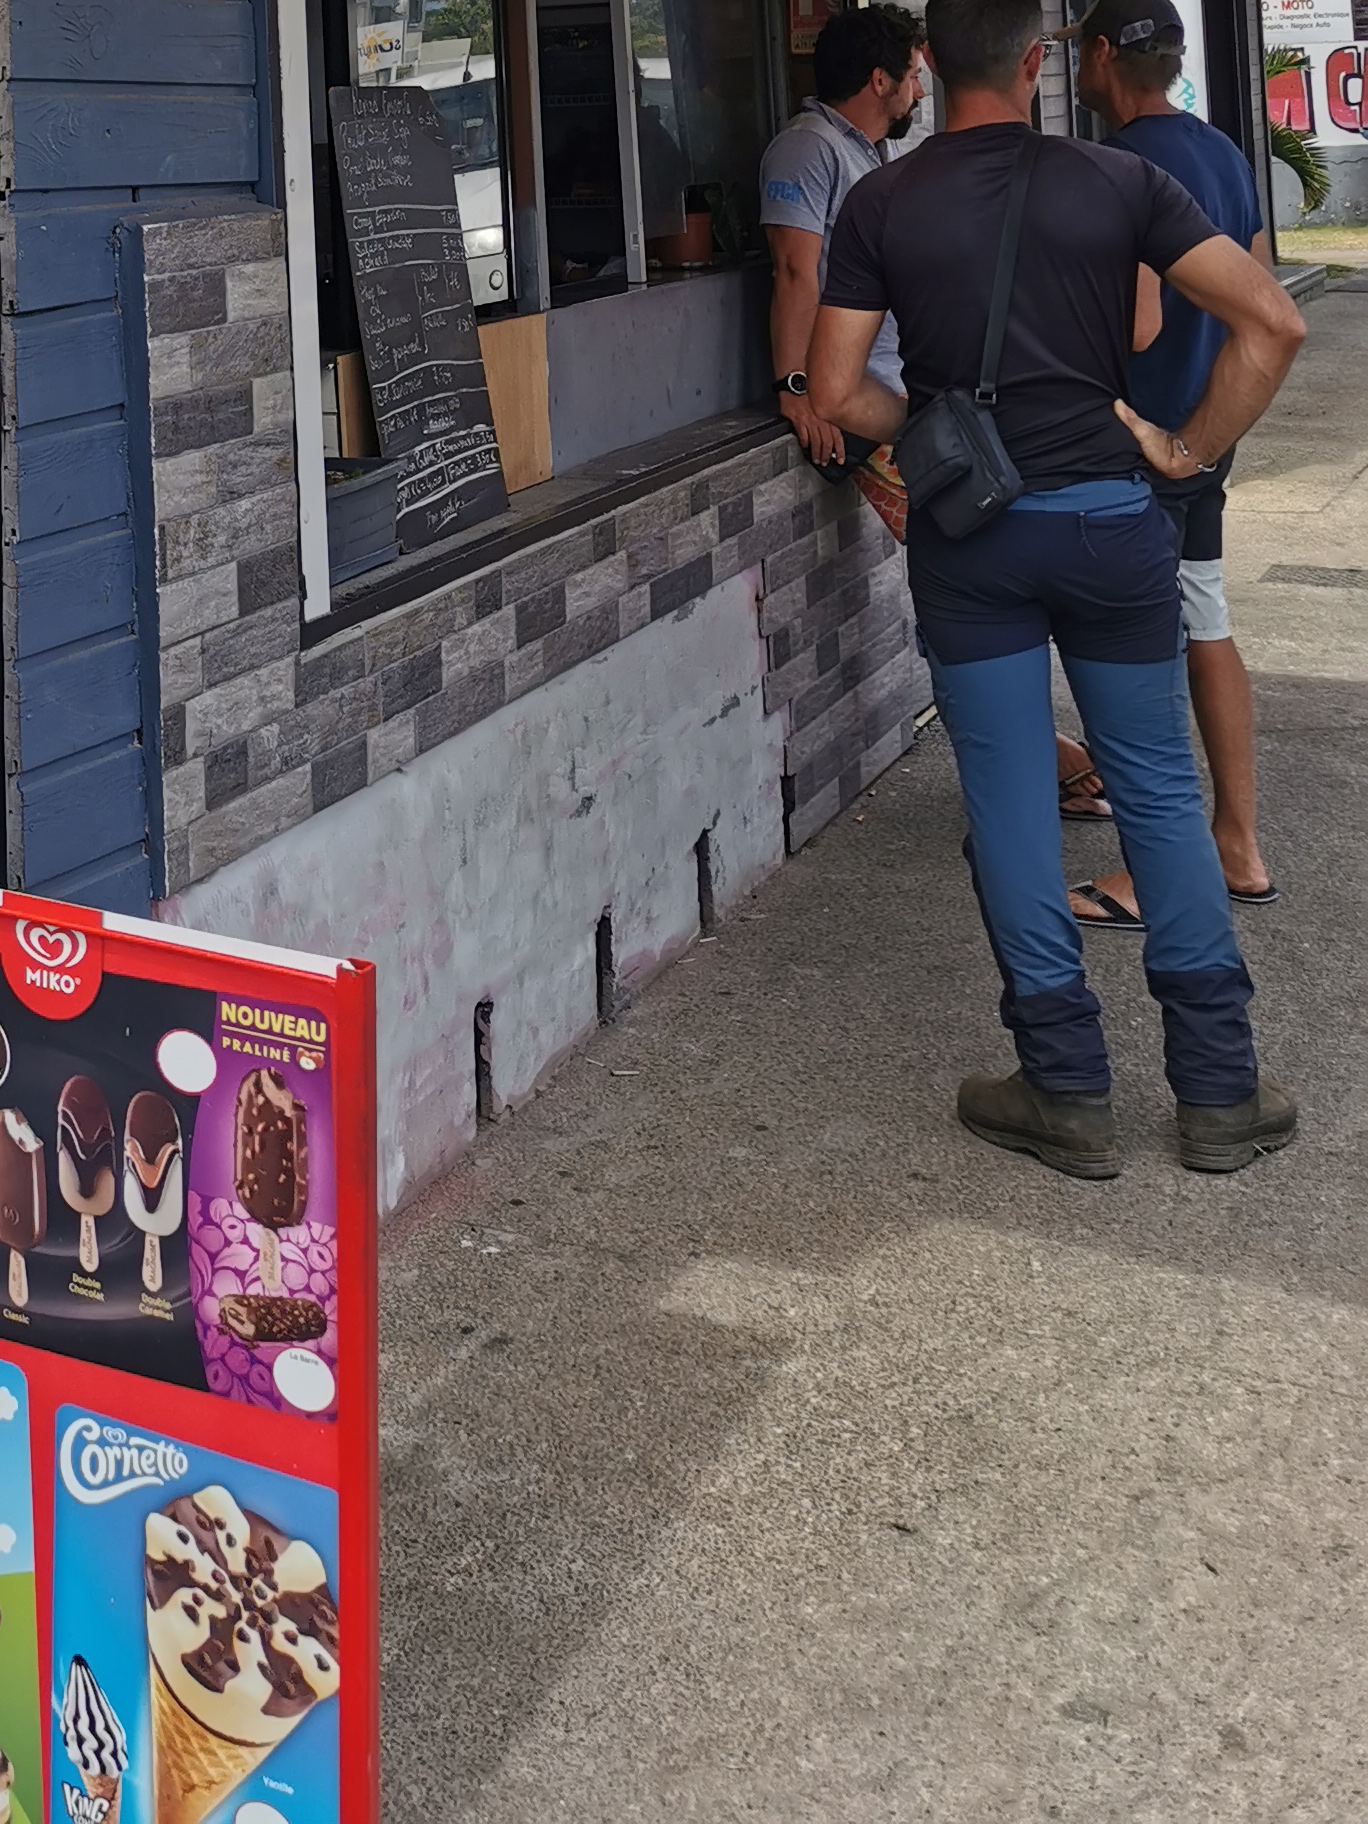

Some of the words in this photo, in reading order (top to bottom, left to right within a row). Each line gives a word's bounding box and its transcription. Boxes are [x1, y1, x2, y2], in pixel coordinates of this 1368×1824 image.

[1281, 0, 1315, 11] MOTO
[25, 965, 76, 995] MIKO
[220, 1000, 327, 1043] NOUVEAU
[222, 1035, 291, 1063] PRALINÉ
[68, 1282, 107, 1302] Chocolat
[71, 1272, 102, 1290] Double
[59, 1417, 189, 1505] Cornetto
